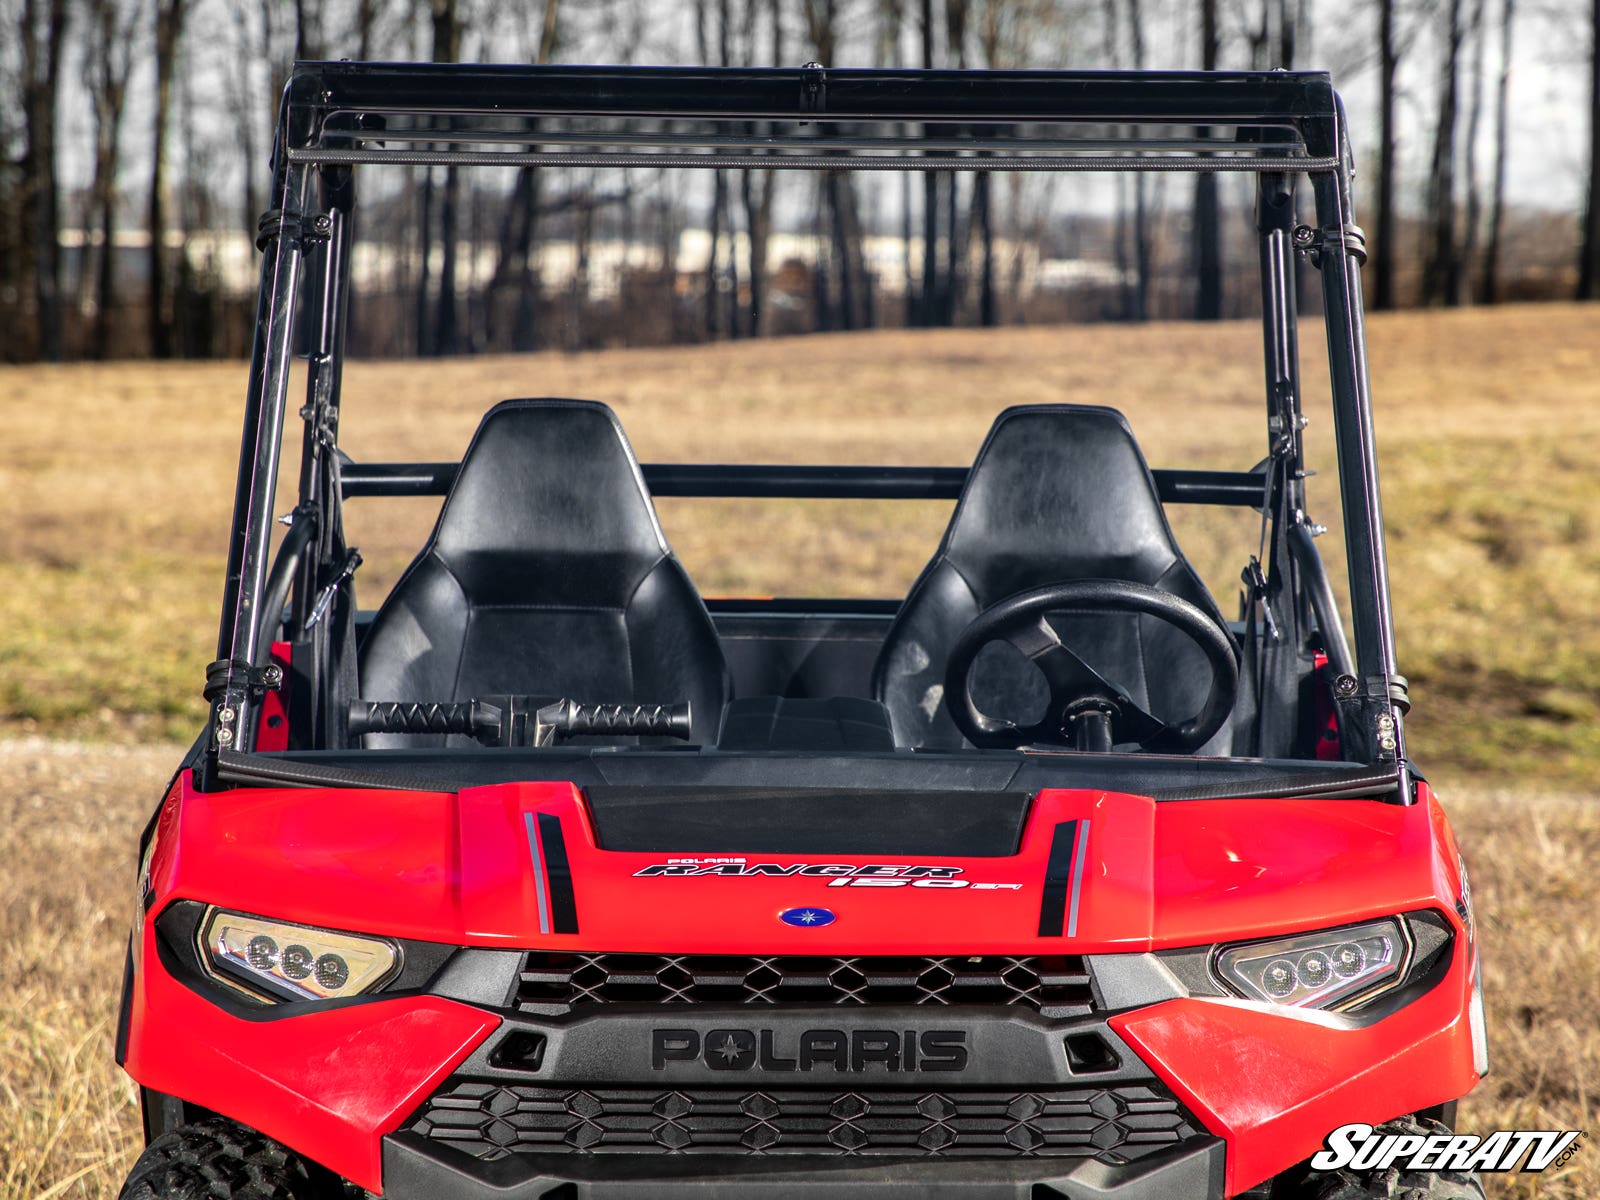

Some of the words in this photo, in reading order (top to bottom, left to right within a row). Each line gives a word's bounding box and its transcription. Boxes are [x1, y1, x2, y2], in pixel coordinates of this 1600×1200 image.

[632, 863, 966, 878] RANGER
[826, 876, 971, 889] 150
[651, 1029, 968, 1072] POLARIS
